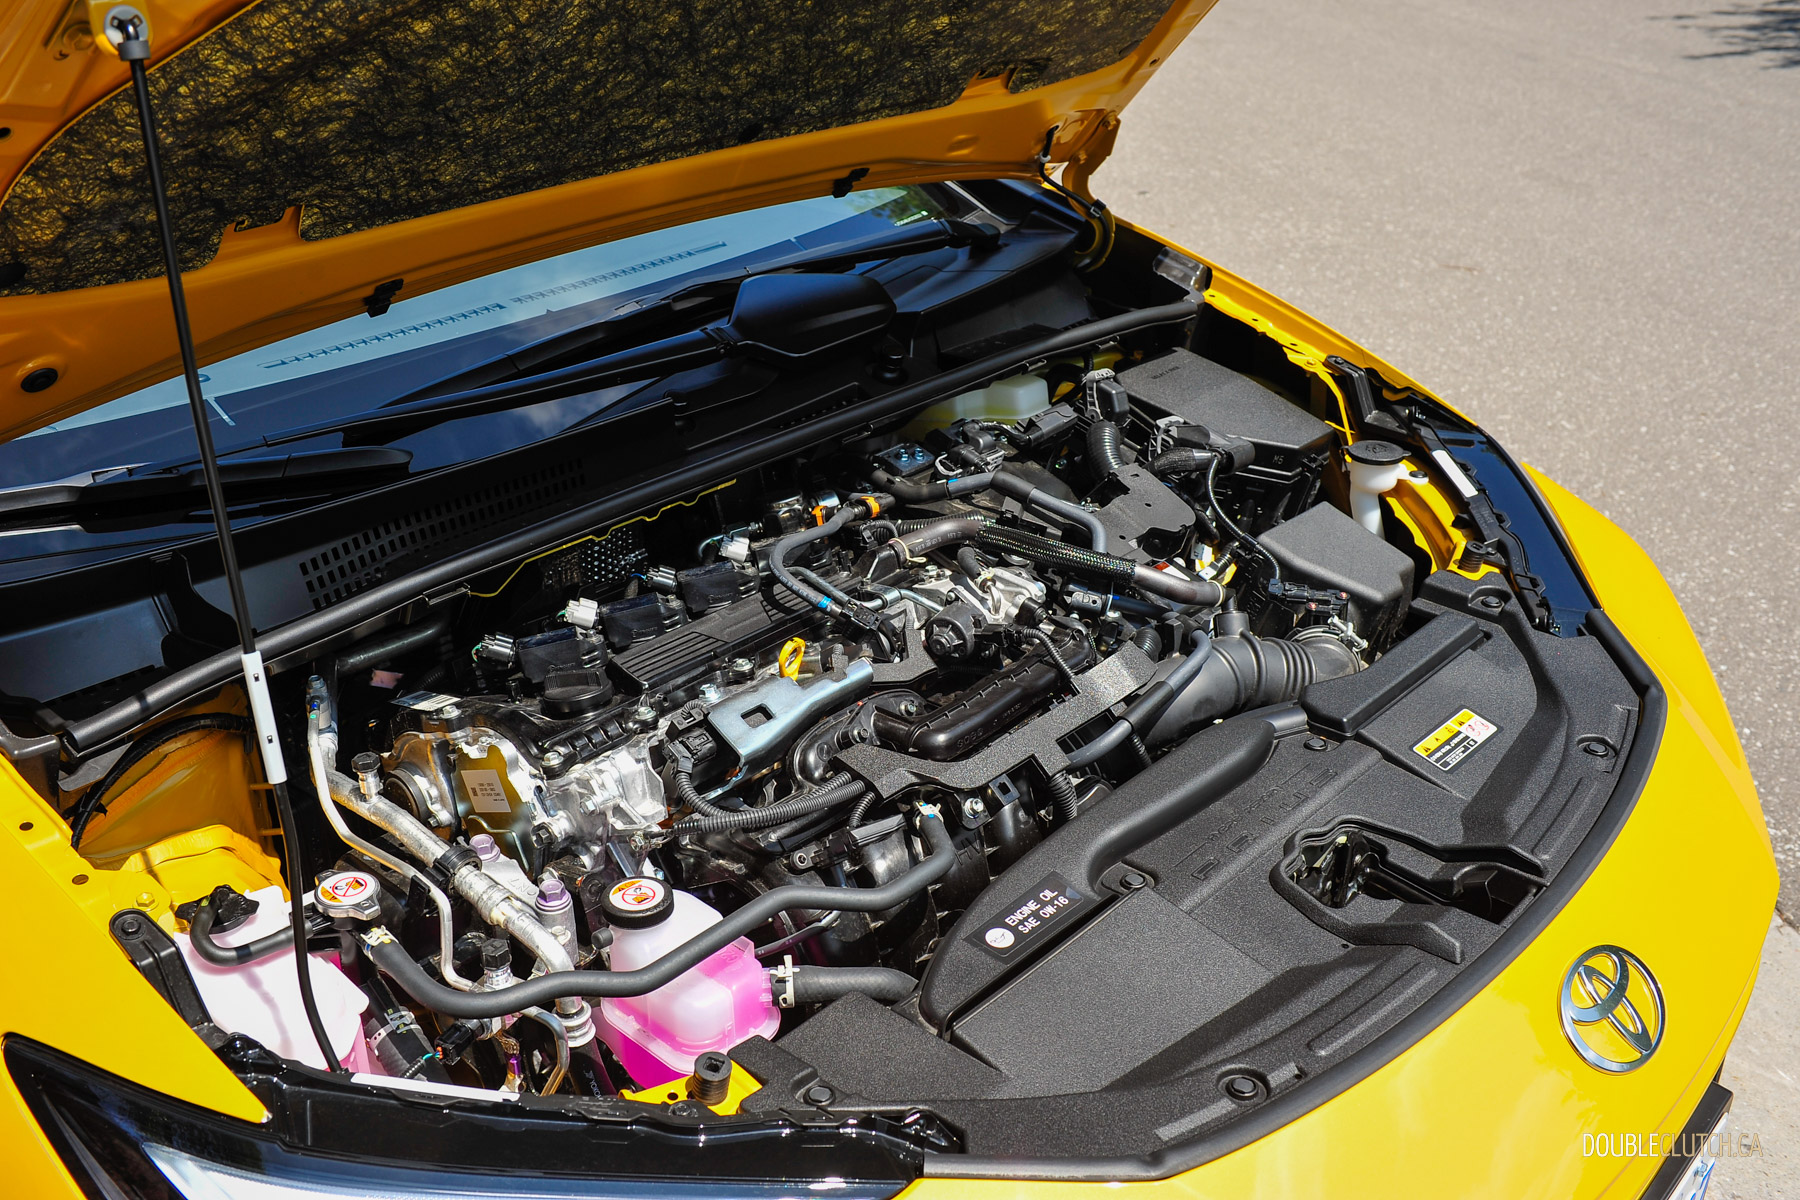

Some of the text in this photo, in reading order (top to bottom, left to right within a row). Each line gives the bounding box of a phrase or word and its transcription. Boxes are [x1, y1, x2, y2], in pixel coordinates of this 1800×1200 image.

[1004, 889, 1059, 927] ENGINE OIL
[1018, 896, 1069, 934] SAE 0W-16
